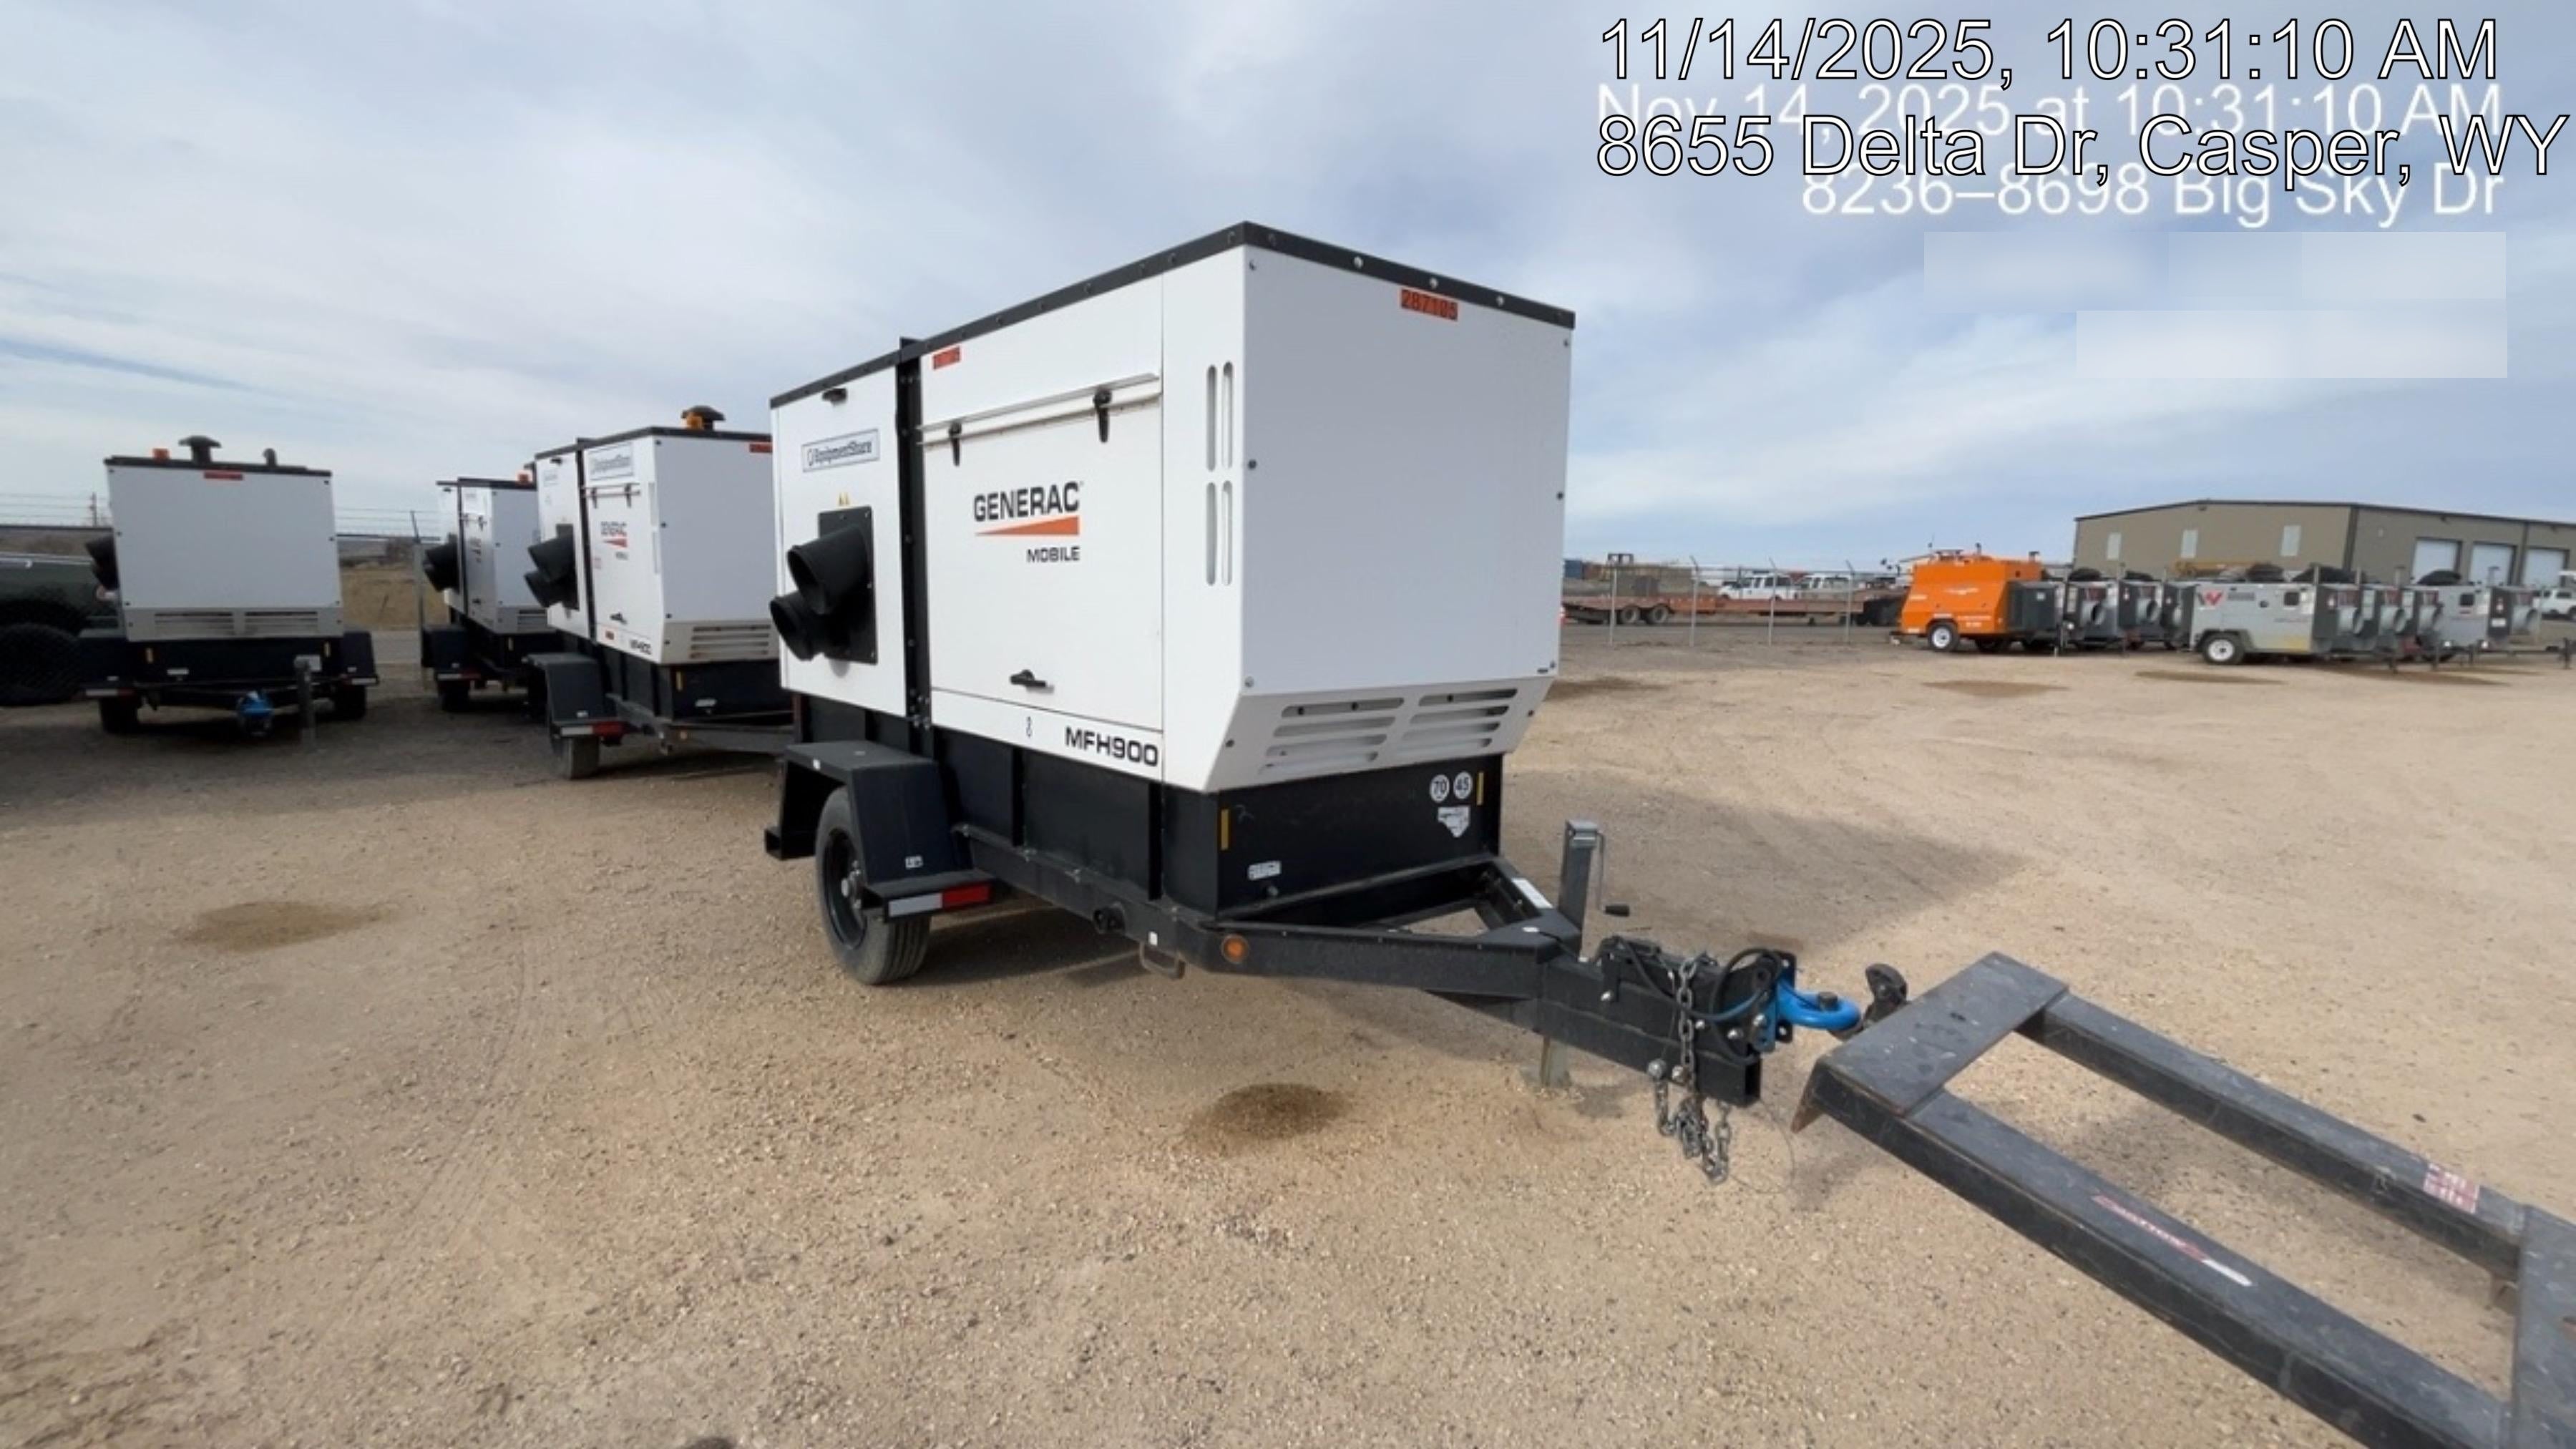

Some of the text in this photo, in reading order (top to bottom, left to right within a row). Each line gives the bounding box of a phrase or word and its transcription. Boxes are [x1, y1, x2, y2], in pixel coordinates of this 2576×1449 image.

[974, 480, 1080, 522] GENERAC
[1026, 546, 1080, 563] MOBILE
[1065, 726, 1158, 767] MFH900
[1433, 779, 1448, 794] 70
[1455, 776, 1470, 791] 45
